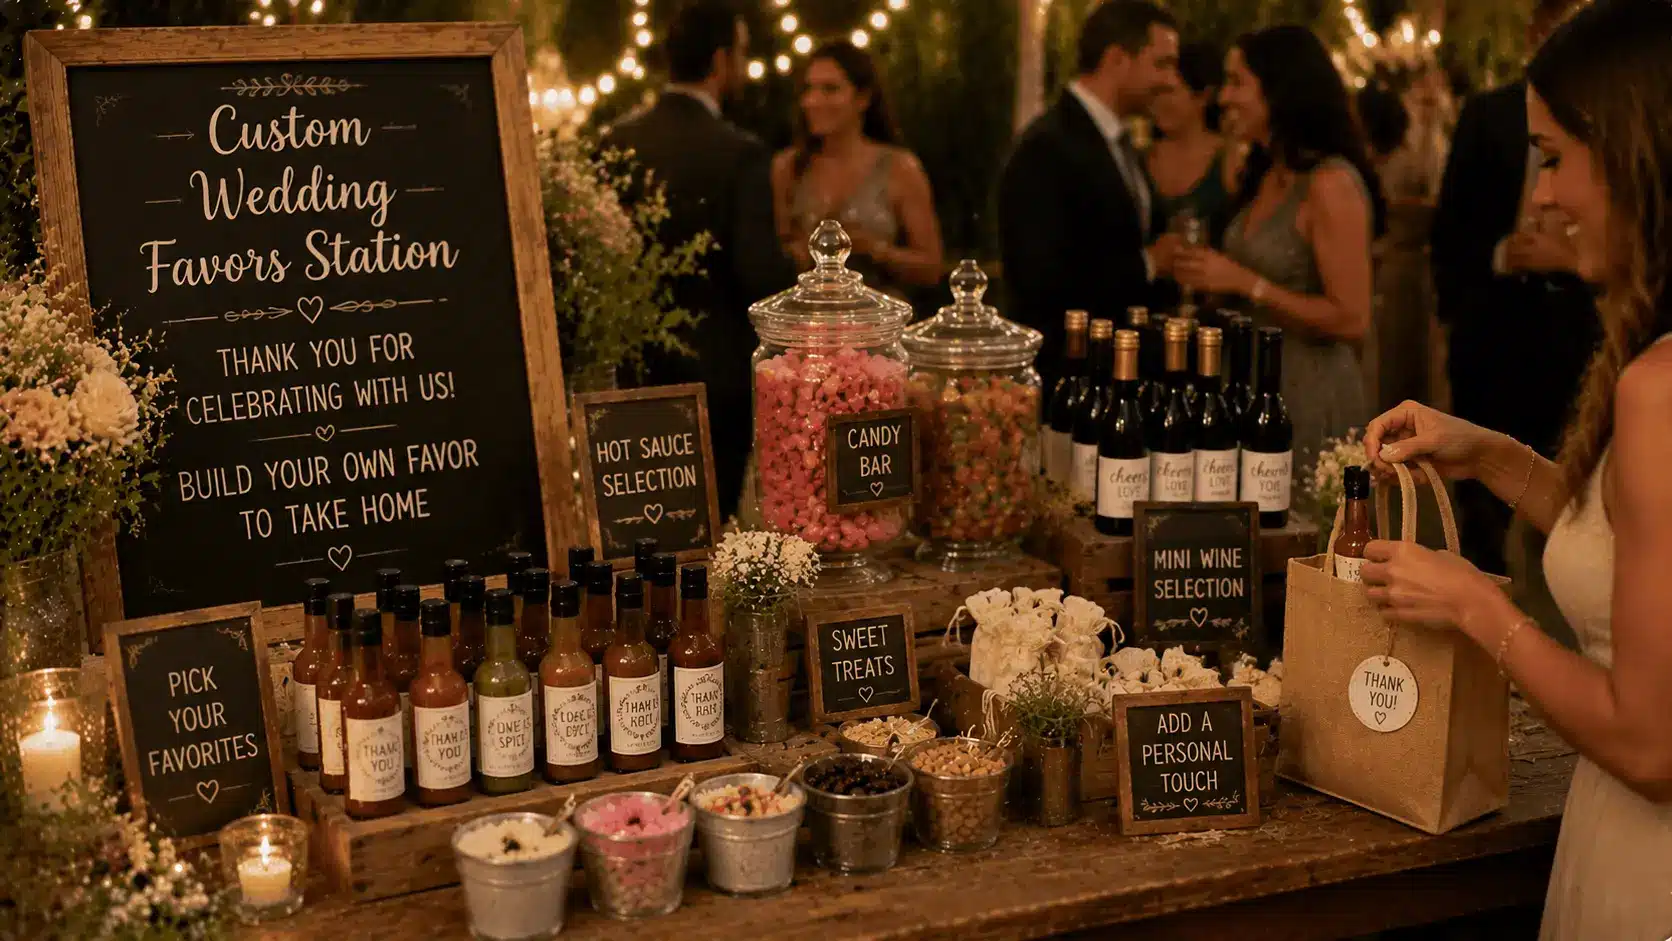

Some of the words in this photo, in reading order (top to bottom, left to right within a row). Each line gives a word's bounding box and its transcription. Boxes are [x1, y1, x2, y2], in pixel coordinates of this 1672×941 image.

[209, 105, 371, 154] Custom
[190, 165, 396, 227] Wedding
[140, 239, 291, 293] Favors
[305, 230, 459, 280] Station
[217, 343, 298, 376] THANK
[309, 338, 356, 367] YOU
[370, 333, 414, 362] FOR
[187, 383, 342, 425] CELEBRATING
[354, 376, 407, 406] WITH
[419, 372, 454, 400] US!
[597, 439, 631, 463] HOT
[640, 433, 694, 458] SAUCE
[848, 425, 900, 449] CANDY
[179, 465, 251, 501] BUILD
[264, 456, 330, 490] YOUR
[344, 448, 394, 481] OWN
[407, 439, 478, 473] FAVOR
[860, 454, 891, 477] BAR
[603, 465, 696, 496] SELECTION
[240, 509, 272, 539] TO
[285, 499, 348, 534] TAKE
[362, 489, 430, 524] HOME
[1155, 550, 1190, 569] MINI
[1200, 548, 1241, 568] WINE
[1155, 578, 1243, 598] SELECTION
[832, 625, 888, 651] SWEET
[169, 666, 217, 696] PICK
[832, 655, 894, 681] TREATS
[1363, 671, 1405, 693] THANK
[1369, 691, 1397, 710] YOU!
[169, 702, 226, 733] YOUR
[1158, 713, 1191, 734] ADD
[1202, 711, 1212, 731] A
[149, 733, 258, 776] FAVORITES
[371, 758, 394, 772] YOU
[438, 745, 461, 760] YOU
[1143, 740, 1233, 765] PERSONAL
[1160, 771, 1217, 792] TOUCH
